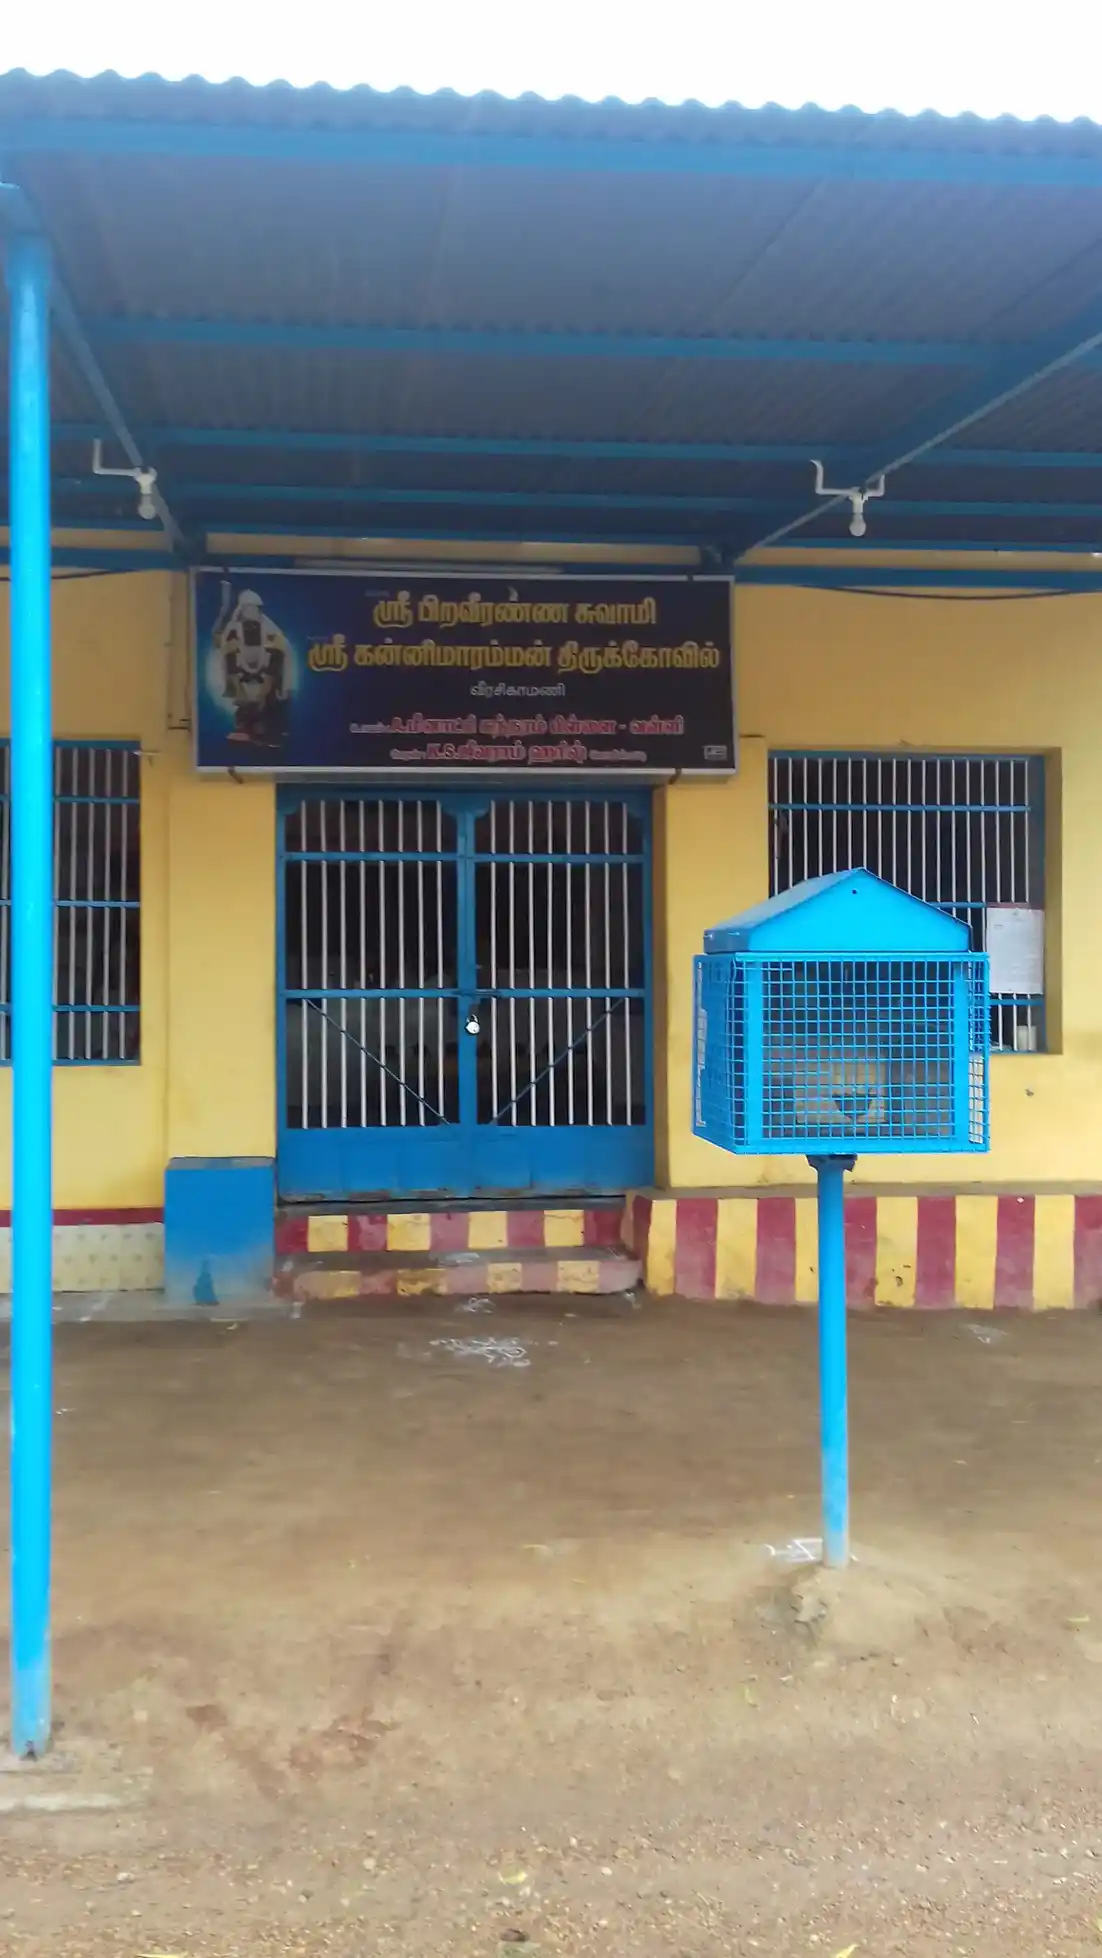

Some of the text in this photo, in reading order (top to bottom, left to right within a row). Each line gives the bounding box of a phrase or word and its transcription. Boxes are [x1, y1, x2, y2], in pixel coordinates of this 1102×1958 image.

[373, 590, 412, 628] ஸ்ரீ
[574, 596, 657, 626] சுவாமி
[308, 634, 720, 675] ஸ்ரீ கன்னிமாரம்மன் திருக்கோவில்
[470, 681, 566, 699] வீரசிகாமணி
